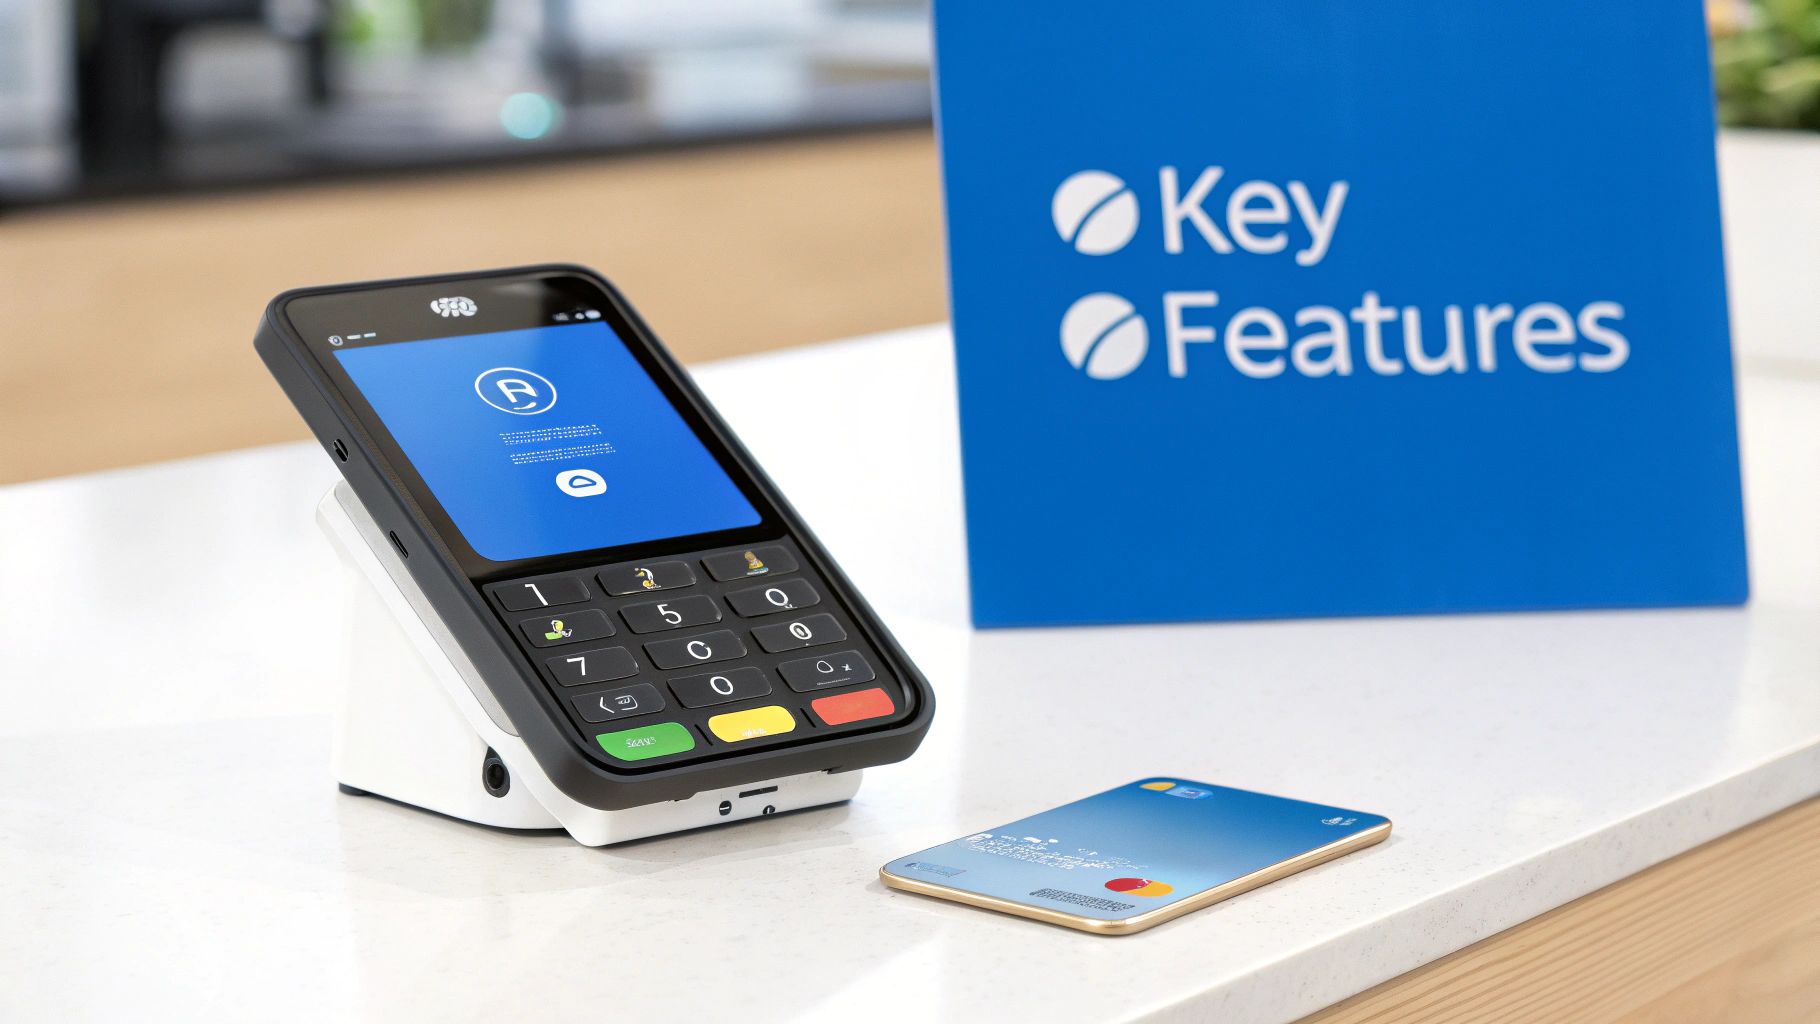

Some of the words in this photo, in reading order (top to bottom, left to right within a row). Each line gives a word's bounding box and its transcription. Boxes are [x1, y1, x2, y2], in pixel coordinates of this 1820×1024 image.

[1159, 166, 1349, 266] Key
[1163, 290, 1631, 378] Features
[656, 603, 682, 625] 5
[566, 656, 587, 677] 7
